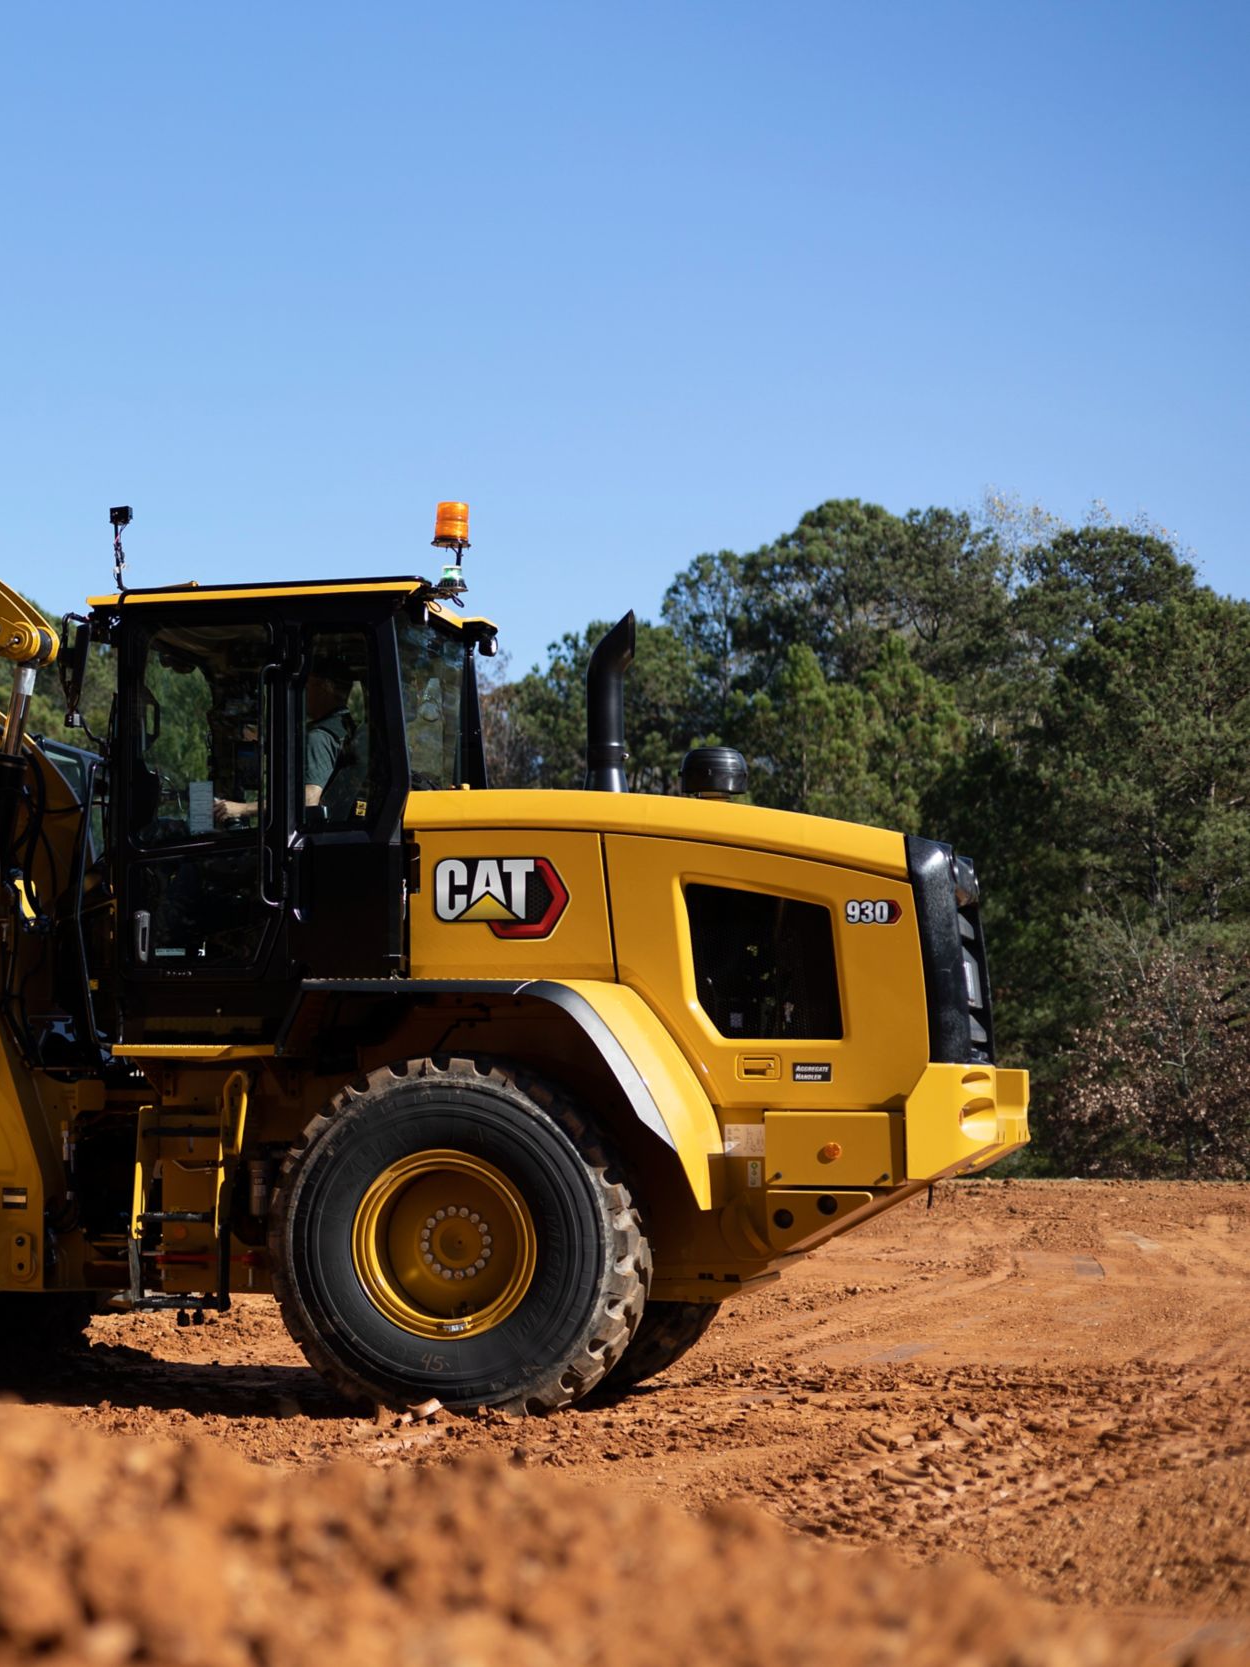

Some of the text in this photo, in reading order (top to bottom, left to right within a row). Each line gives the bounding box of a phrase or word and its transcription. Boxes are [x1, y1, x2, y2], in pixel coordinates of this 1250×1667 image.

[436, 859, 534, 920] CAT
[846, 901, 889, 923] 930
[421, 1353, 445, 1371] 45
